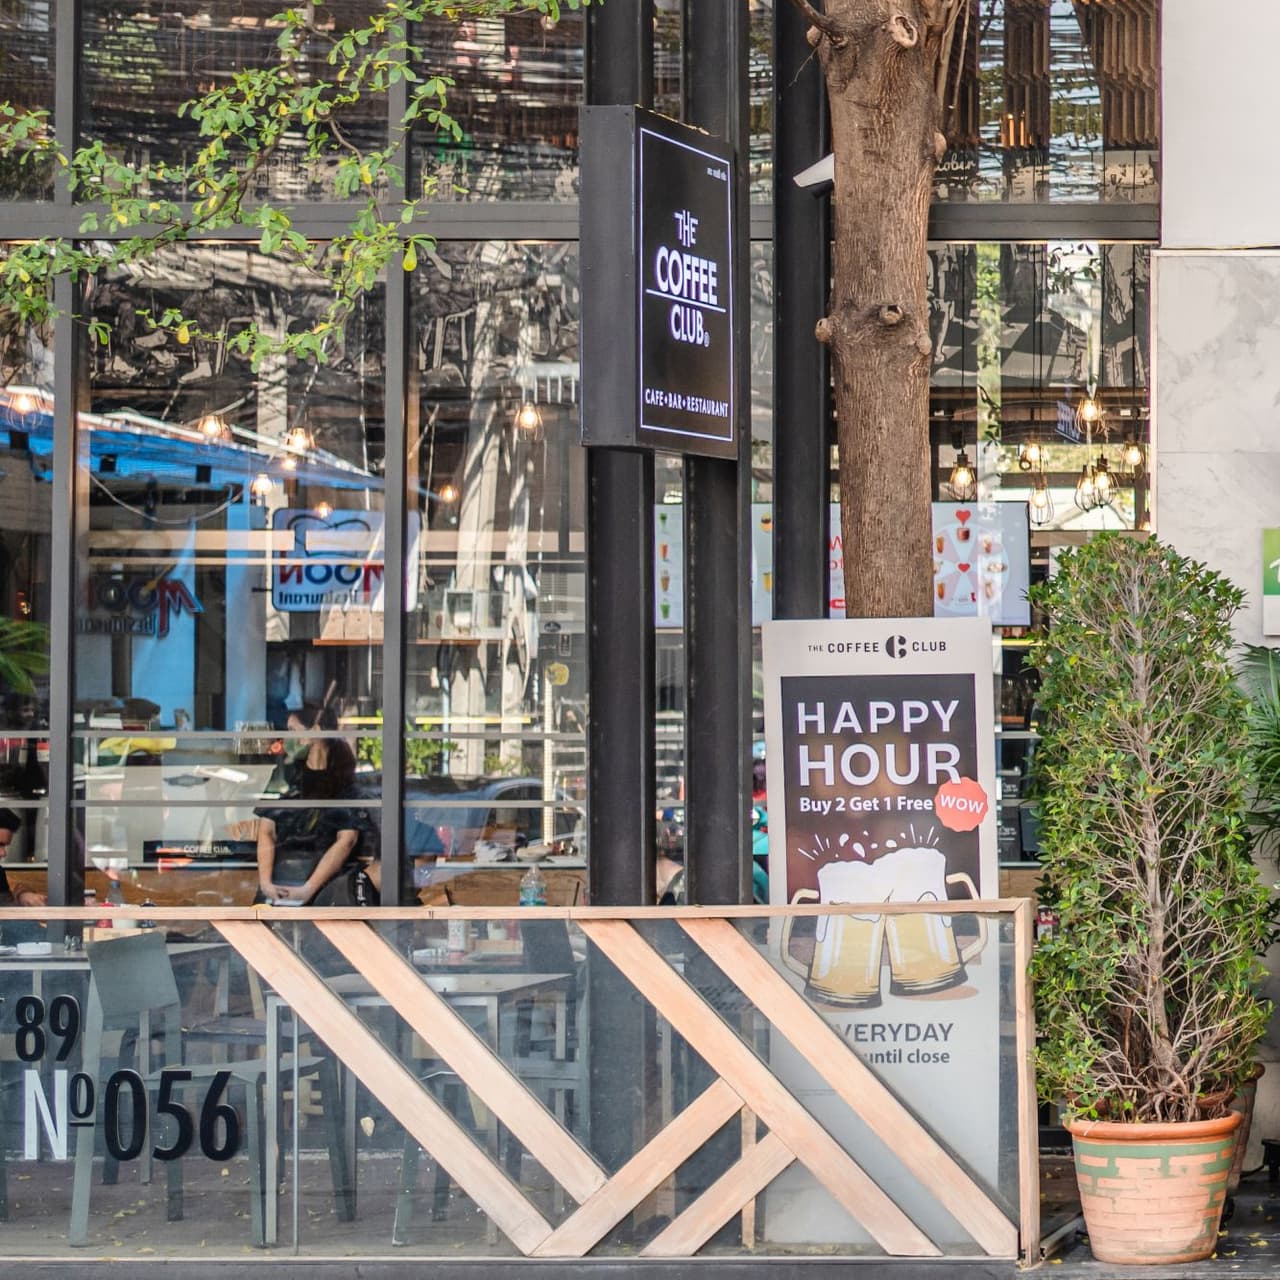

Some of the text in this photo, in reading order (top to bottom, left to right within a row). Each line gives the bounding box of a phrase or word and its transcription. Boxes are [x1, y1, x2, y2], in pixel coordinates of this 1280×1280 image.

[674, 209, 698, 248] THE
[656, 245, 718, 305] COFFEE
[828, 643, 879, 653] COFFEE
[912, 641, 947, 652] CLUB
[797, 700, 959, 734] HAPPY
[799, 743, 961, 786] HOUR
[800, 797, 933, 814] Buy 2 Get 1 Free
[940, 795, 984, 814] WOW
[15, 994, 81, 1062] 89
[837, 1024, 953, 1042] VERYDAY
[907, 1048, 950, 1063] close
